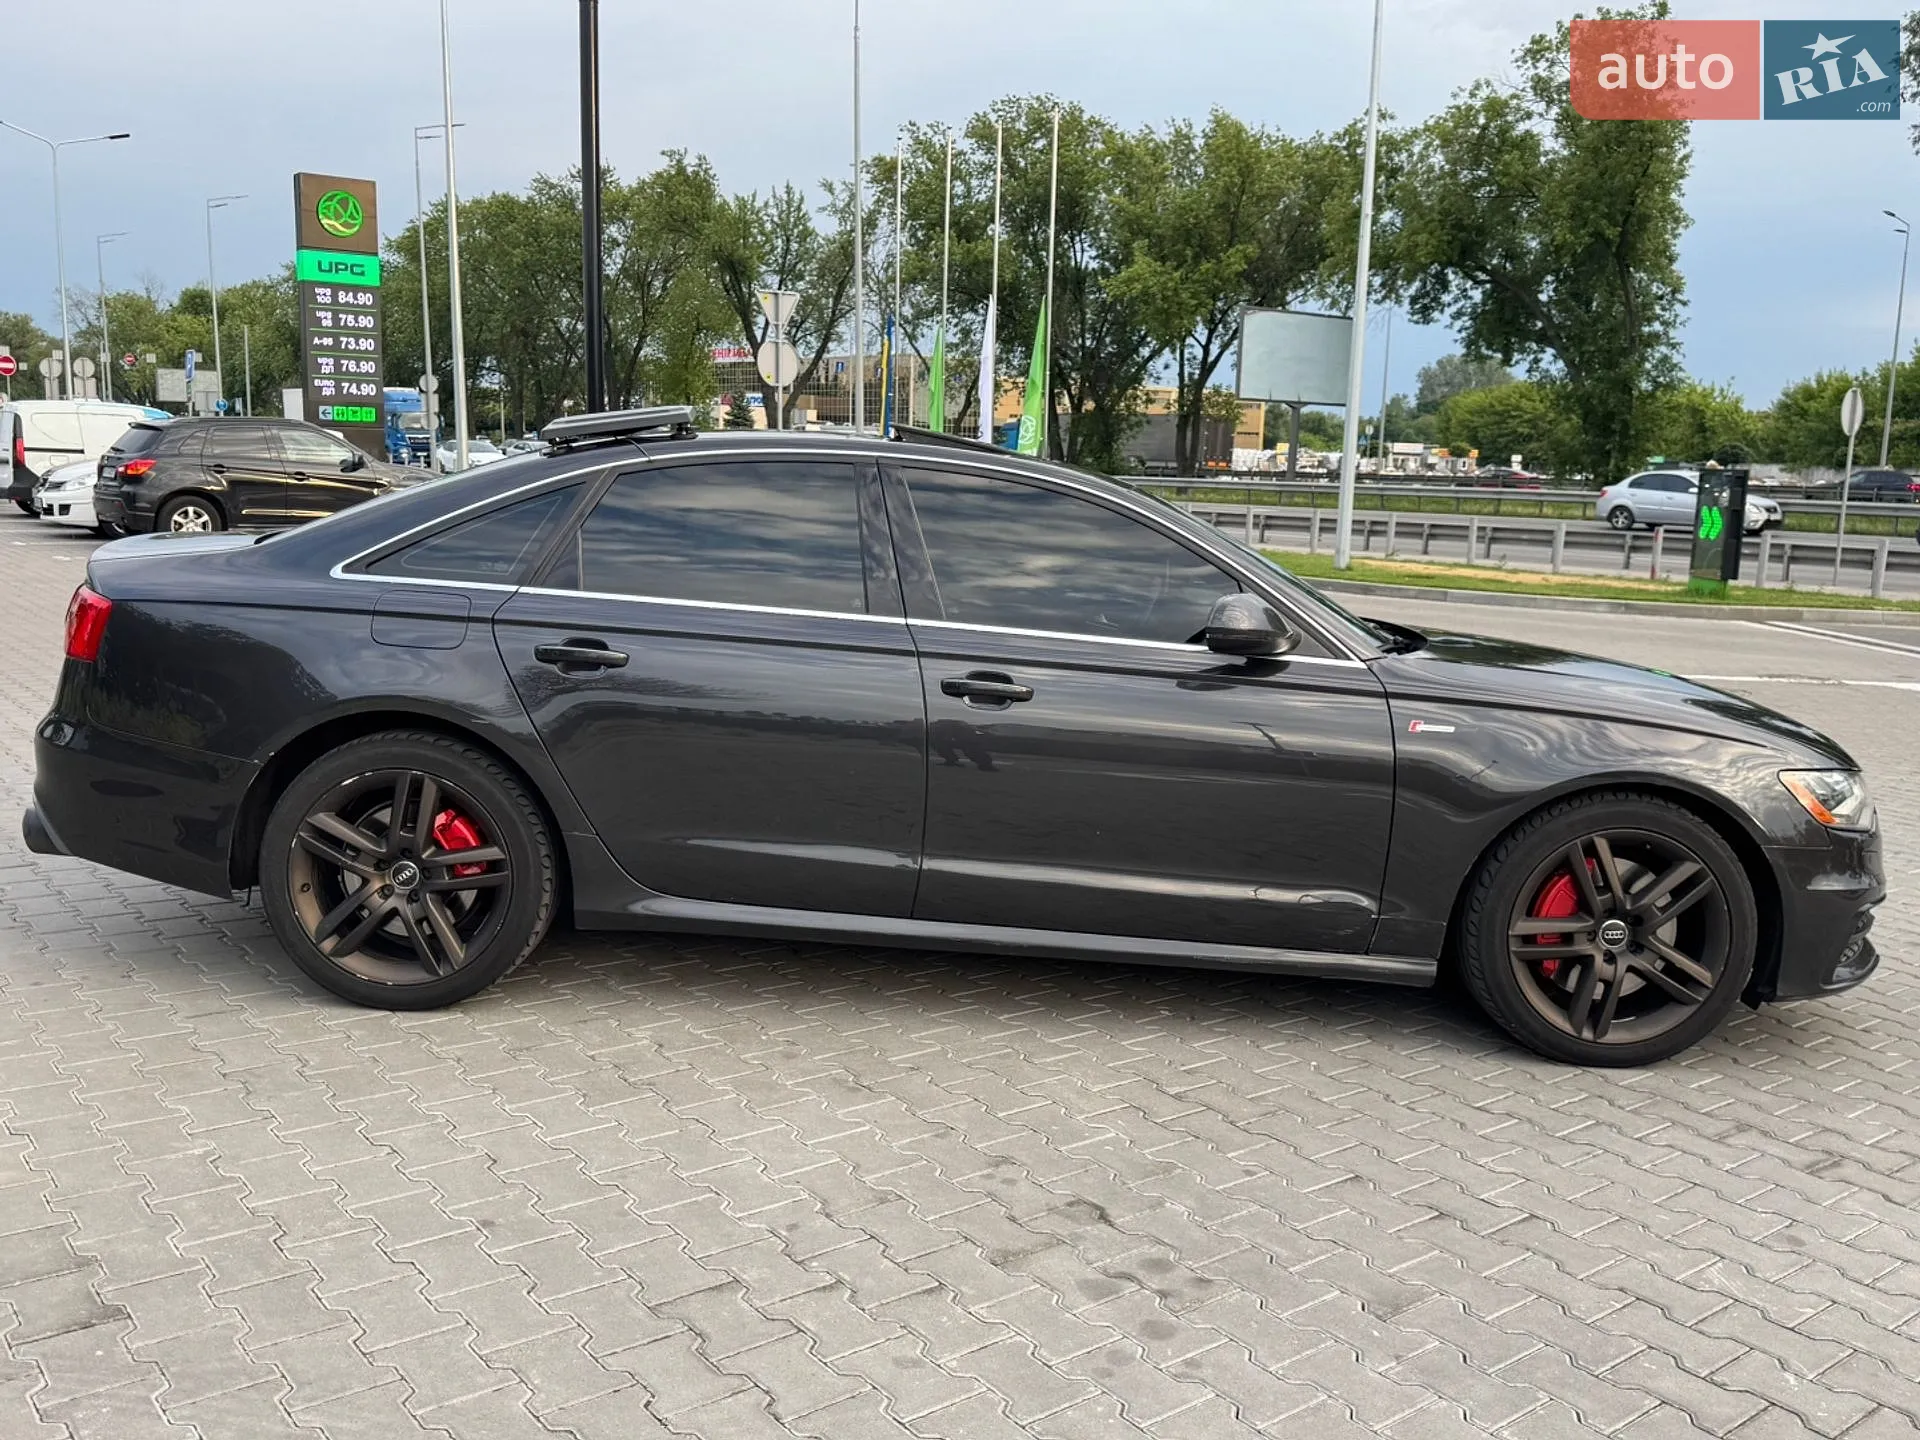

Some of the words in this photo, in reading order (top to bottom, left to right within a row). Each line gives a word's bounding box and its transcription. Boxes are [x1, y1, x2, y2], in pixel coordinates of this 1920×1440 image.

[317, 260, 366, 277] UPG
[316, 296, 332, 304] 100
[338, 291, 373, 305] 84.90
[338, 314, 374, 328] 75.90
[339, 337, 375, 351] 73.90
[340, 359, 376, 373] 76.90
[341, 383, 377, 396] 74.90
